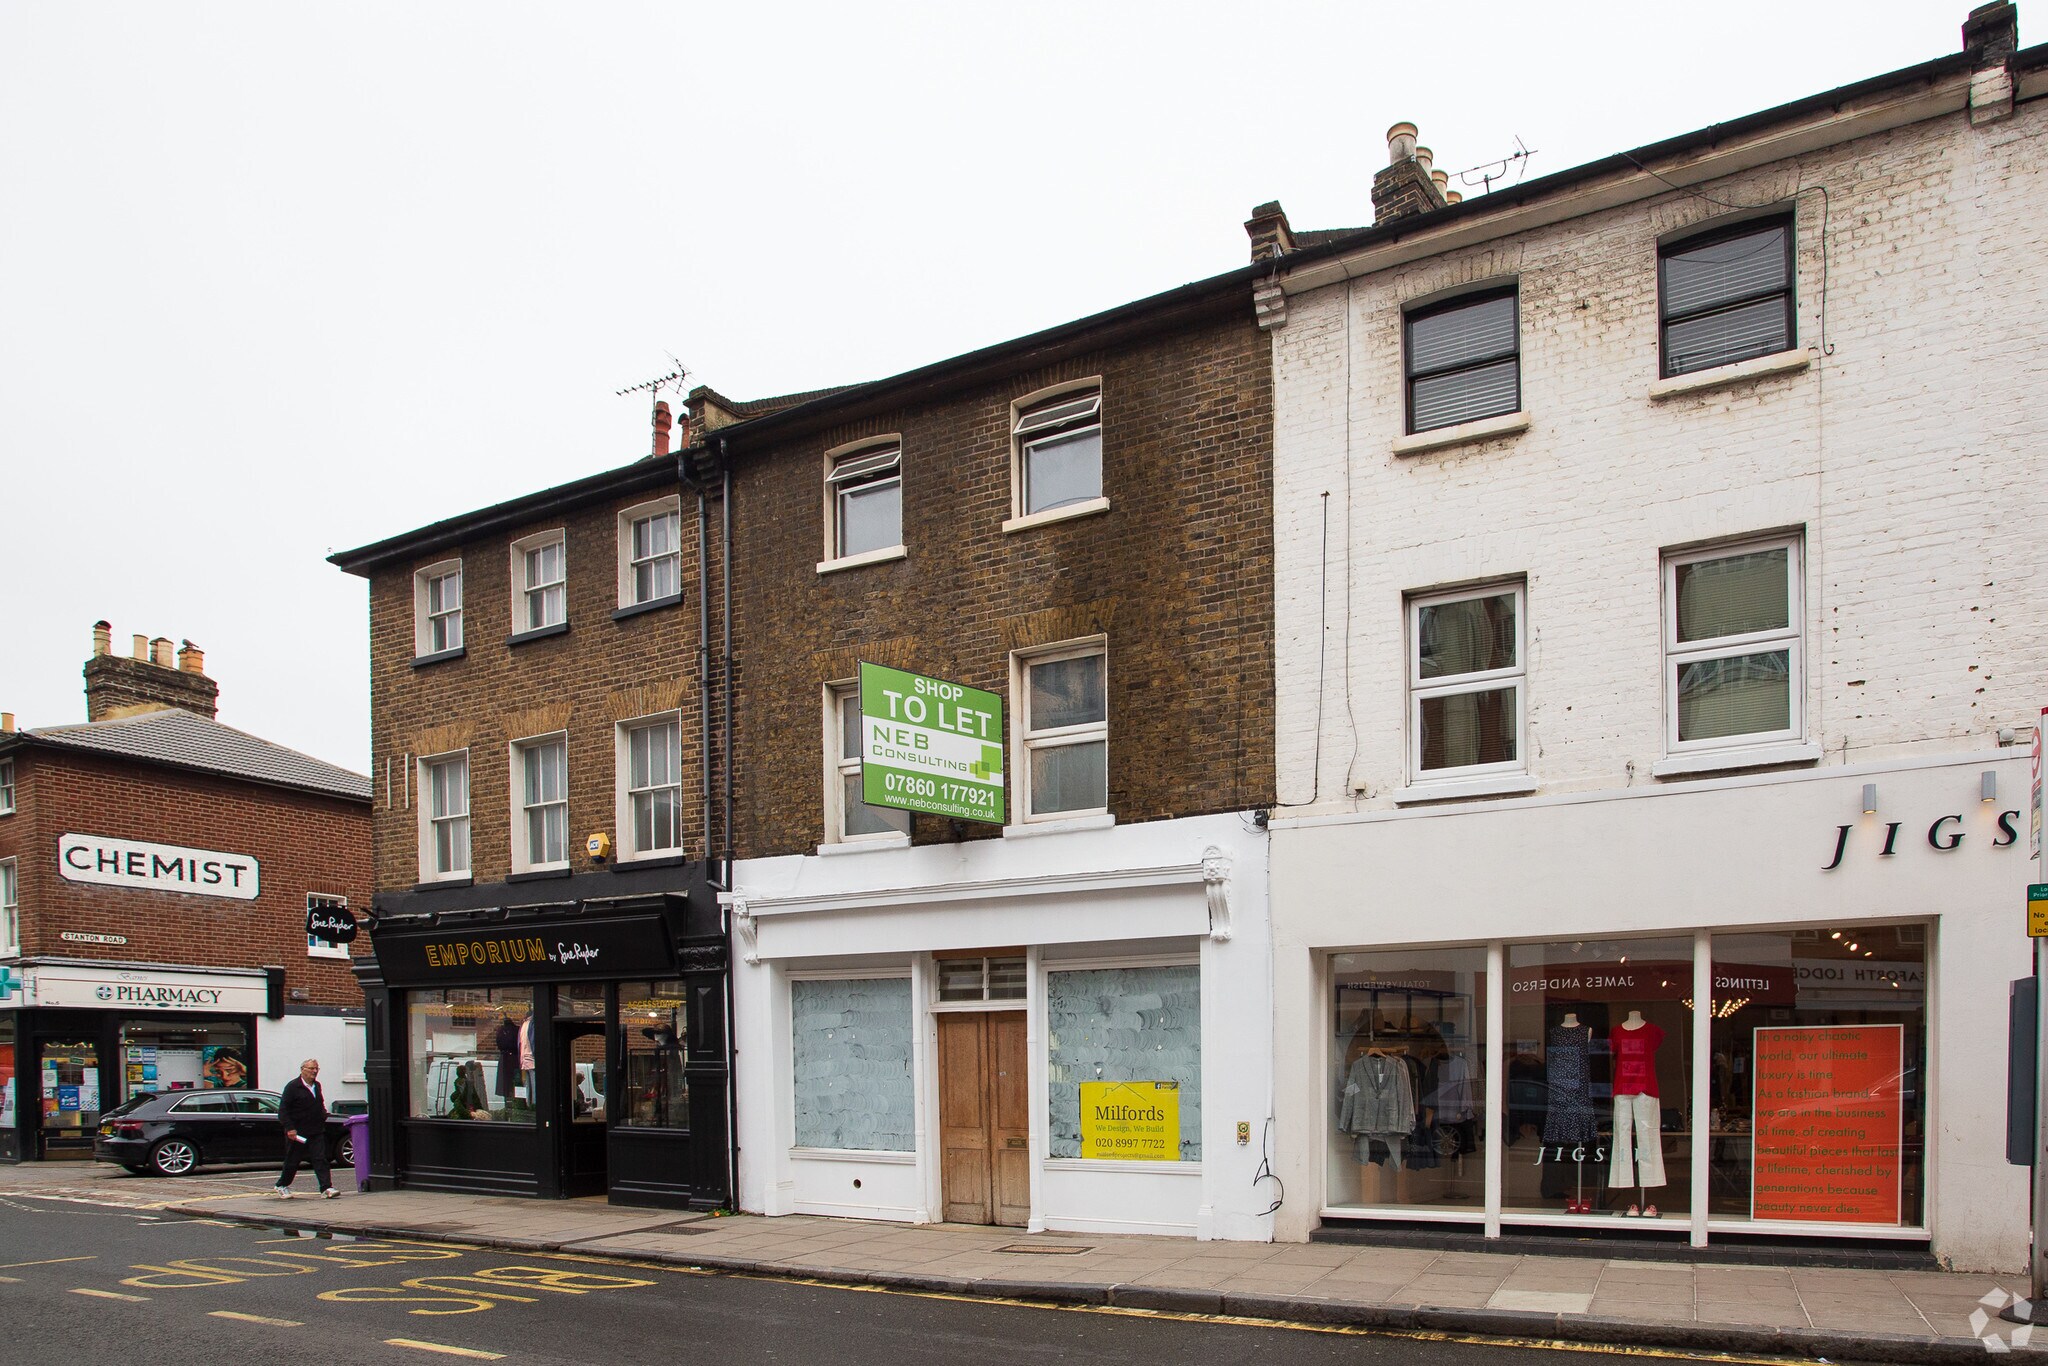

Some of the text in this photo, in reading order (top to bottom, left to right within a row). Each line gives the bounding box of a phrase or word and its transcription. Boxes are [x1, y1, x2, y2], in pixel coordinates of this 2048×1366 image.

[914, 677, 963, 702] SHOP
[882, 689, 992, 737] TO LET
[873, 724, 929, 750] NEB
[872, 744, 967, 772] CONSULTING
[885, 773, 995, 807] 07860 177921
[884, 794, 995, 819] www.nebconsulting.co.uk
[1821, 810, 2020, 870] JIGS
[65, 846, 247, 887] CHEMIST
[311, 912, 354, 934] Sue Ryder
[64, 932, 124, 944] STANTON ROAD
[425, 938, 600, 967] EMPORIUM by Sue Ryder
[117, 986, 222, 1004] PHARMACY
[1759, 1031, 1861, 1043] In a noisy chaotic
[1759, 1049, 1868, 1062] world, our ultimate
[1758, 1069, 1793, 1081] luxury
[1797, 1070, 1805, 1080] is
[1758, 1089, 1771, 1099] As
[1776, 1090, 1783, 1099] a
[1787, 1087, 1829, 1099] fashion
[1095, 1105, 1165, 1121] Milfords
[1758, 1107, 1886, 1118] we are in the business
[1107, 1125, 1132, 1134] Design,
[1146, 1125, 1164, 1133] Build
[1757, 1126, 1768, 1136] of
[1802, 1126, 1814, 1137] of
[1818, 1127, 1866, 1140] creating
[1095, 1138, 1165, 1149] 020 8997 7722
[1757, 1144, 1807, 1155] beautiful
[1810, 1146, 1848, 1158] pieces
[1851, 1146, 1874, 1157] that
[1756, 1165, 1764, 1173] a
[1815, 1165, 1872, 1176] cherished
[1876, 1165, 1892, 1179] by
[1756, 1183, 1878, 1195] generations because
[1755, 1202, 1795, 1214] beauty
[1799, 1204, 1831, 1213] never
[119, 1243, 464, 1288] STOP
[316, 1265, 659, 1315] BUS
